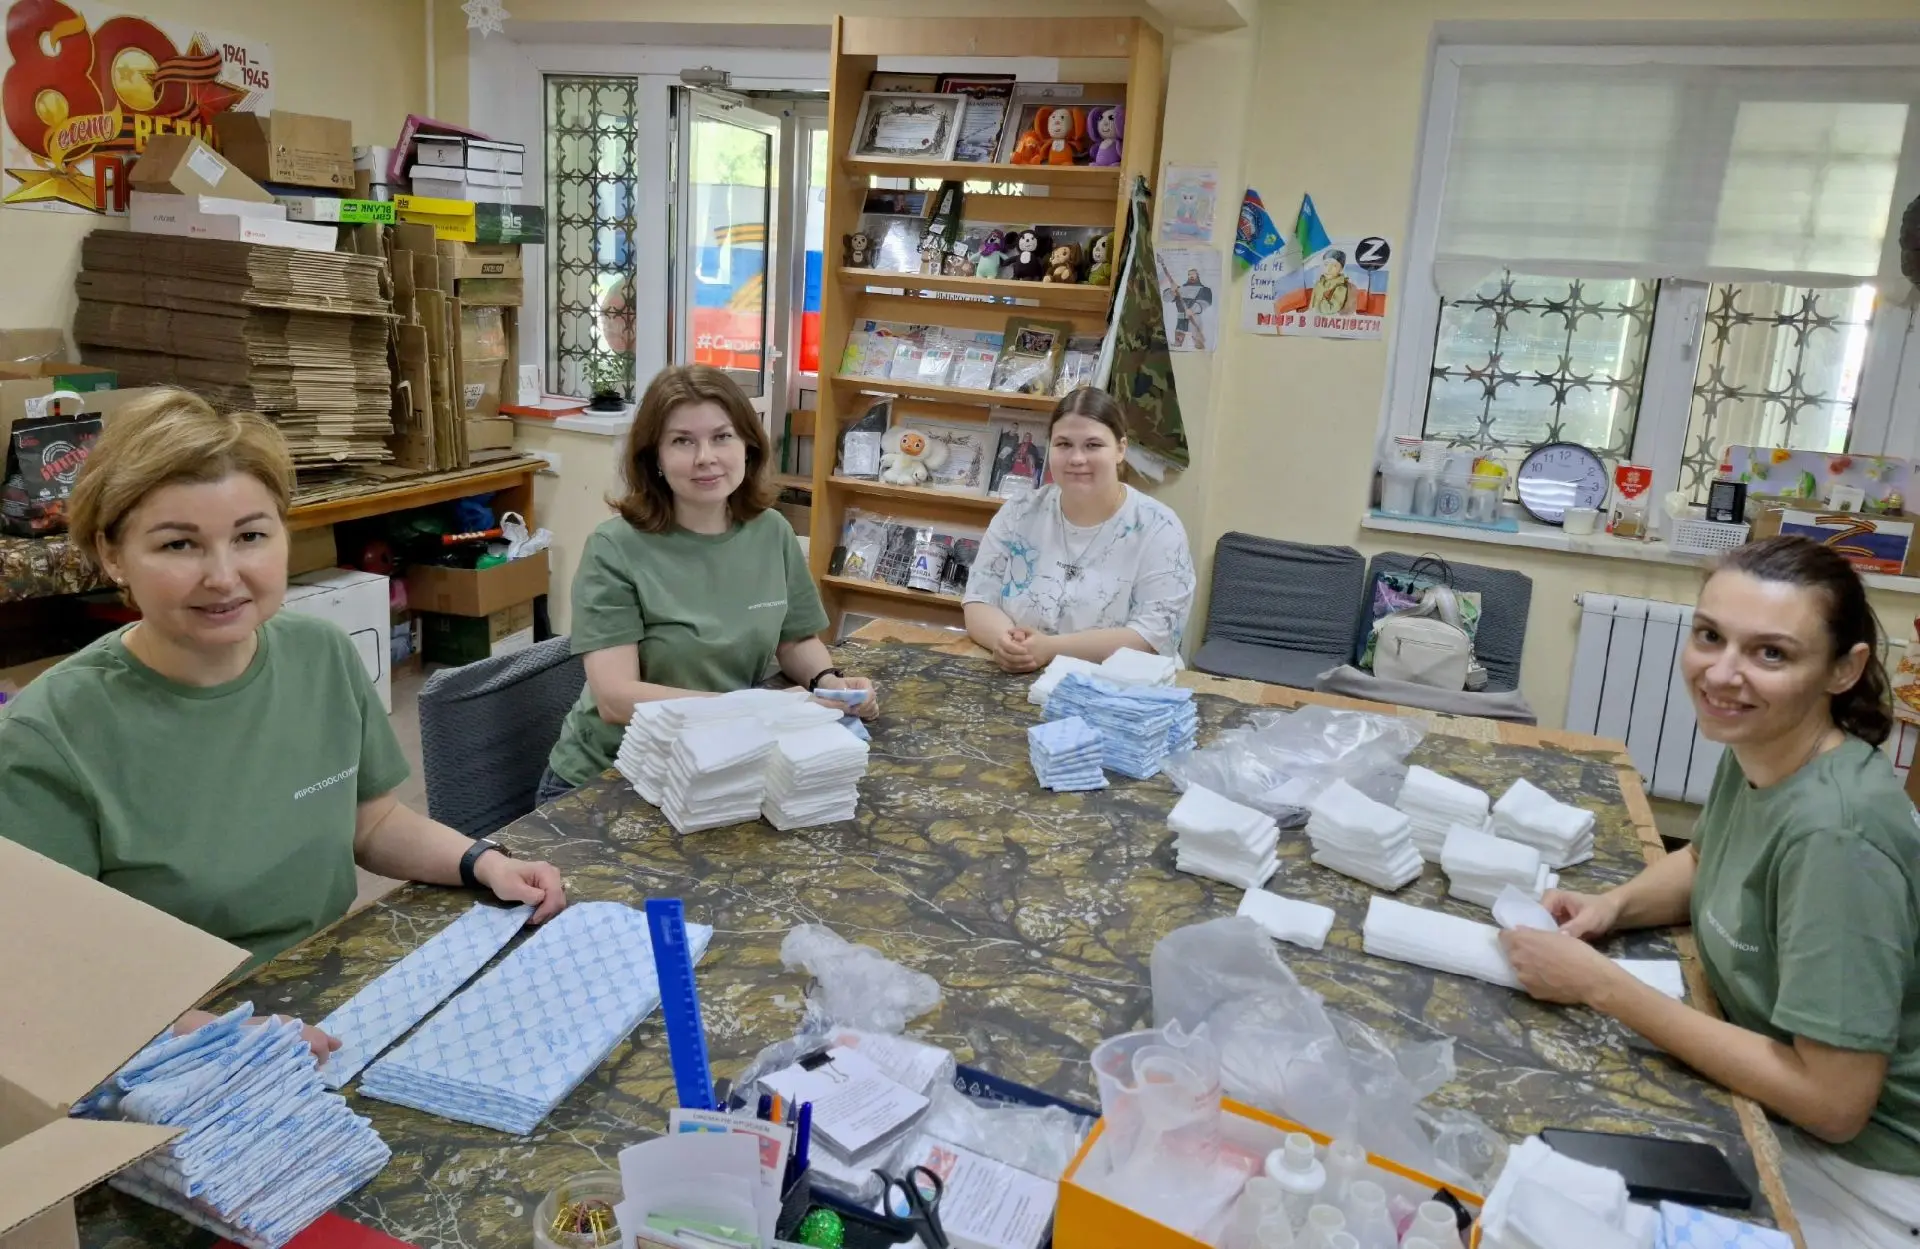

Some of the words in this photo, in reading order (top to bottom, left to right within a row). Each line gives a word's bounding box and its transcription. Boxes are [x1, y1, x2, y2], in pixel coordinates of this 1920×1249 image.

[222, 43, 246, 66] 1941
[3, 0, 190, 160] 80
[240, 67, 270, 89] 1945
[501, 212, 522, 229] als
[1298, 315, 1307, 328] В
[1313, 315, 1381, 332] ОПАСНОСТИ
[1543, 453, 1554, 464] 11
[1559, 450, 1572, 461] 12
[1579, 456, 1585, 466] 1
[1531, 462, 1543, 474] 10
[1587, 467, 1596, 477] 2
[1592, 482, 1599, 492] 3
[1585, 495, 1592, 505] 4
[294, 765, 358, 801] #ПРОСТООСЛОЖ
